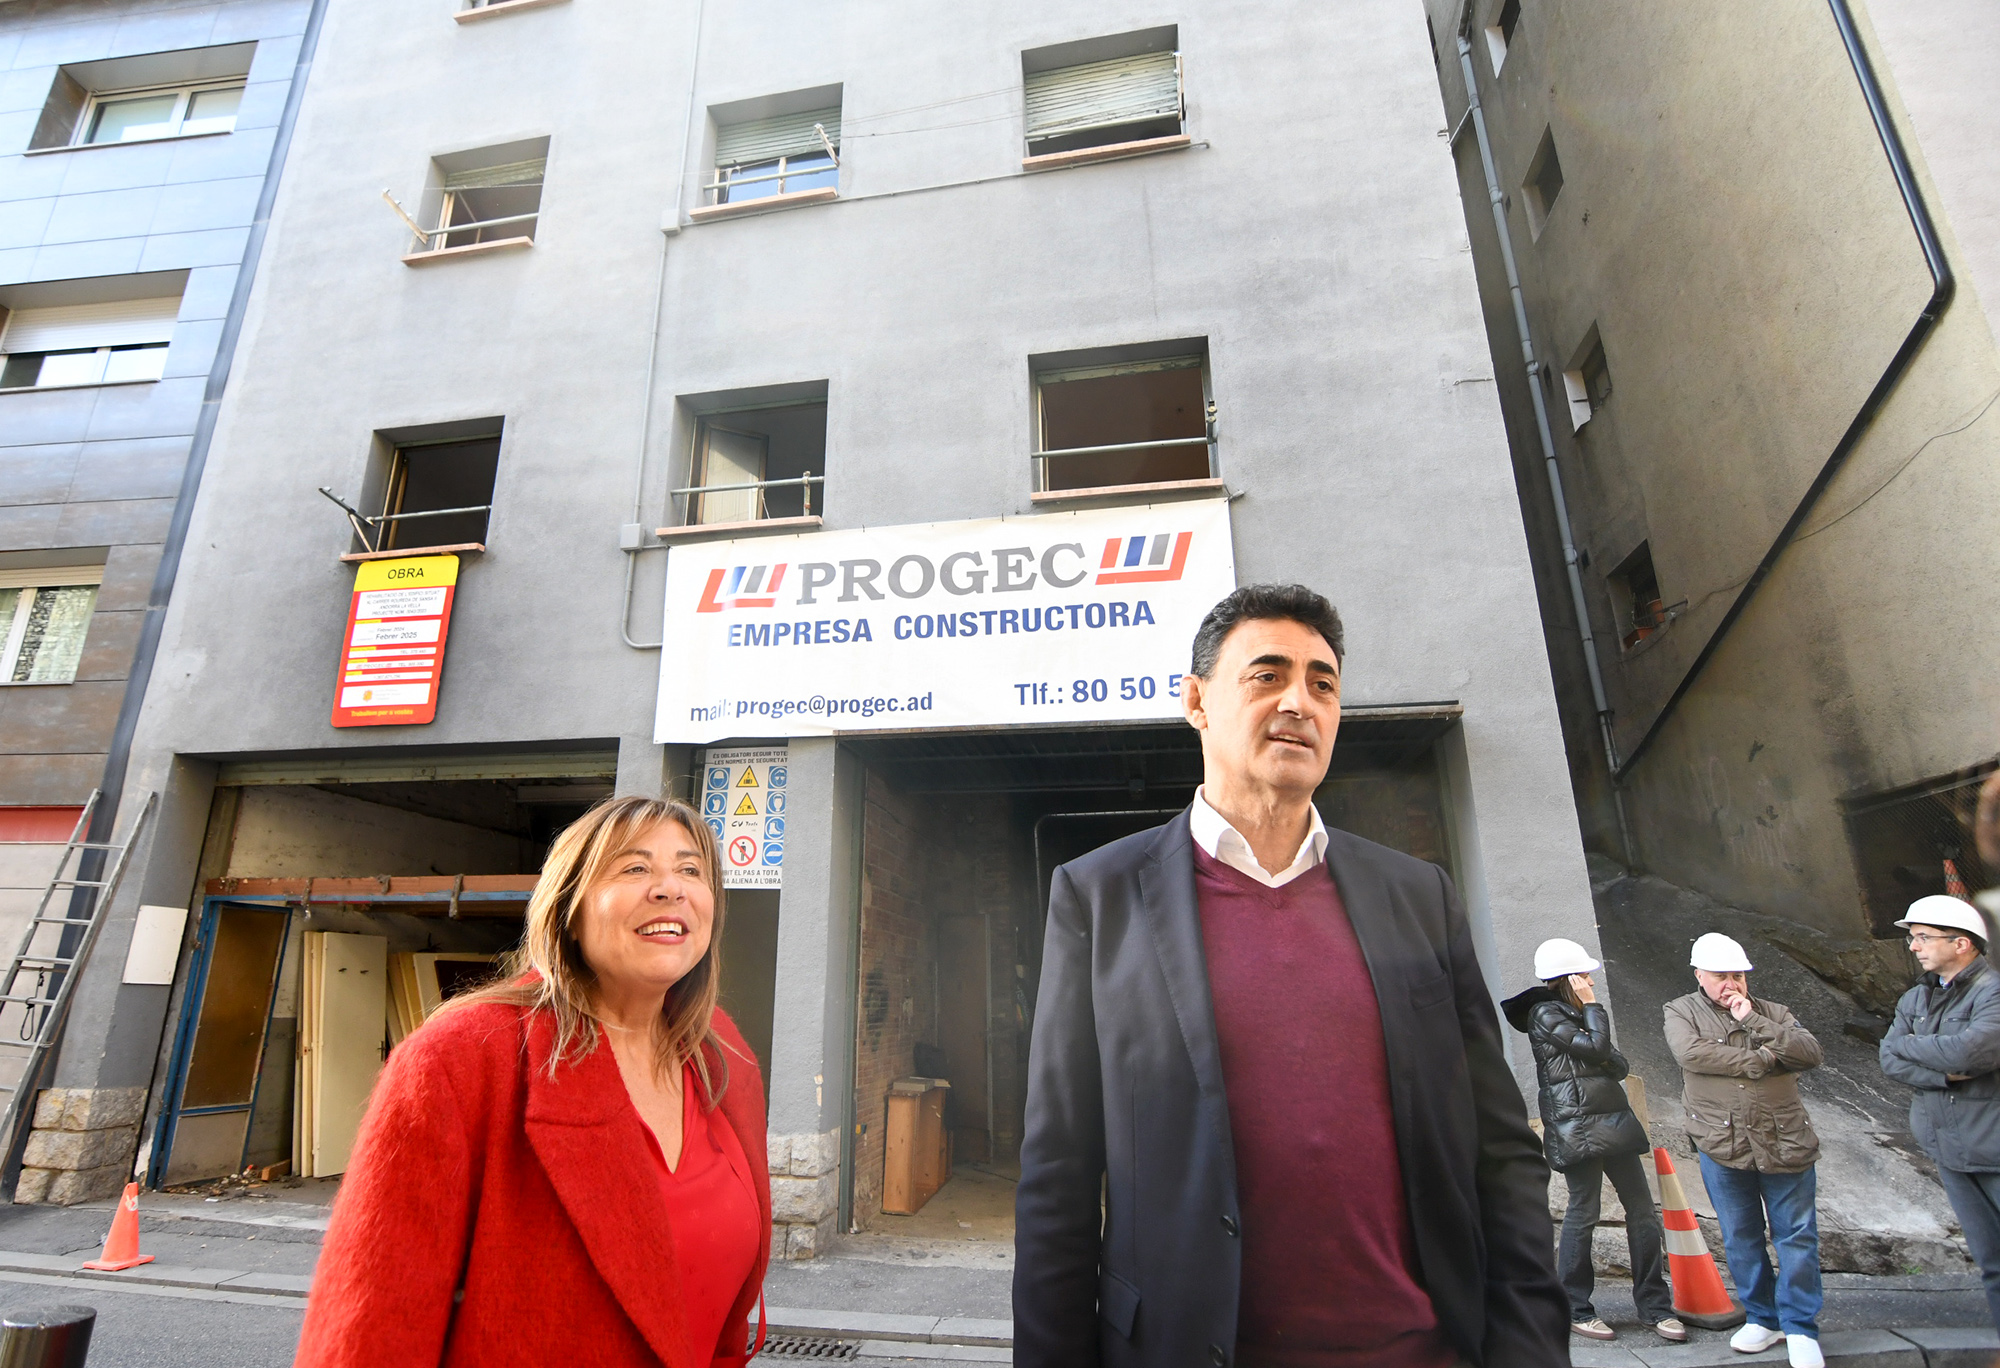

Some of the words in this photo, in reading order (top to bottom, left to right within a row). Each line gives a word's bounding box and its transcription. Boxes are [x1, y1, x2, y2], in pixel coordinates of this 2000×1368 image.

[387, 567, 425, 580] OBRA
[797, 543, 1087, 605] PROGEC
[727, 619, 872, 648] EMPRESA
[895, 601, 1155, 640] CONSTRUCTORA
[1014, 682, 1064, 706] Tlf.:
[1072, 679, 1108, 703] 80
[1120, 676, 1156, 701] 50
[1168, 674, 1183, 698] 5
[691, 699, 733, 721] mail:
[736, 692, 933, 719] progec@progec.ad
